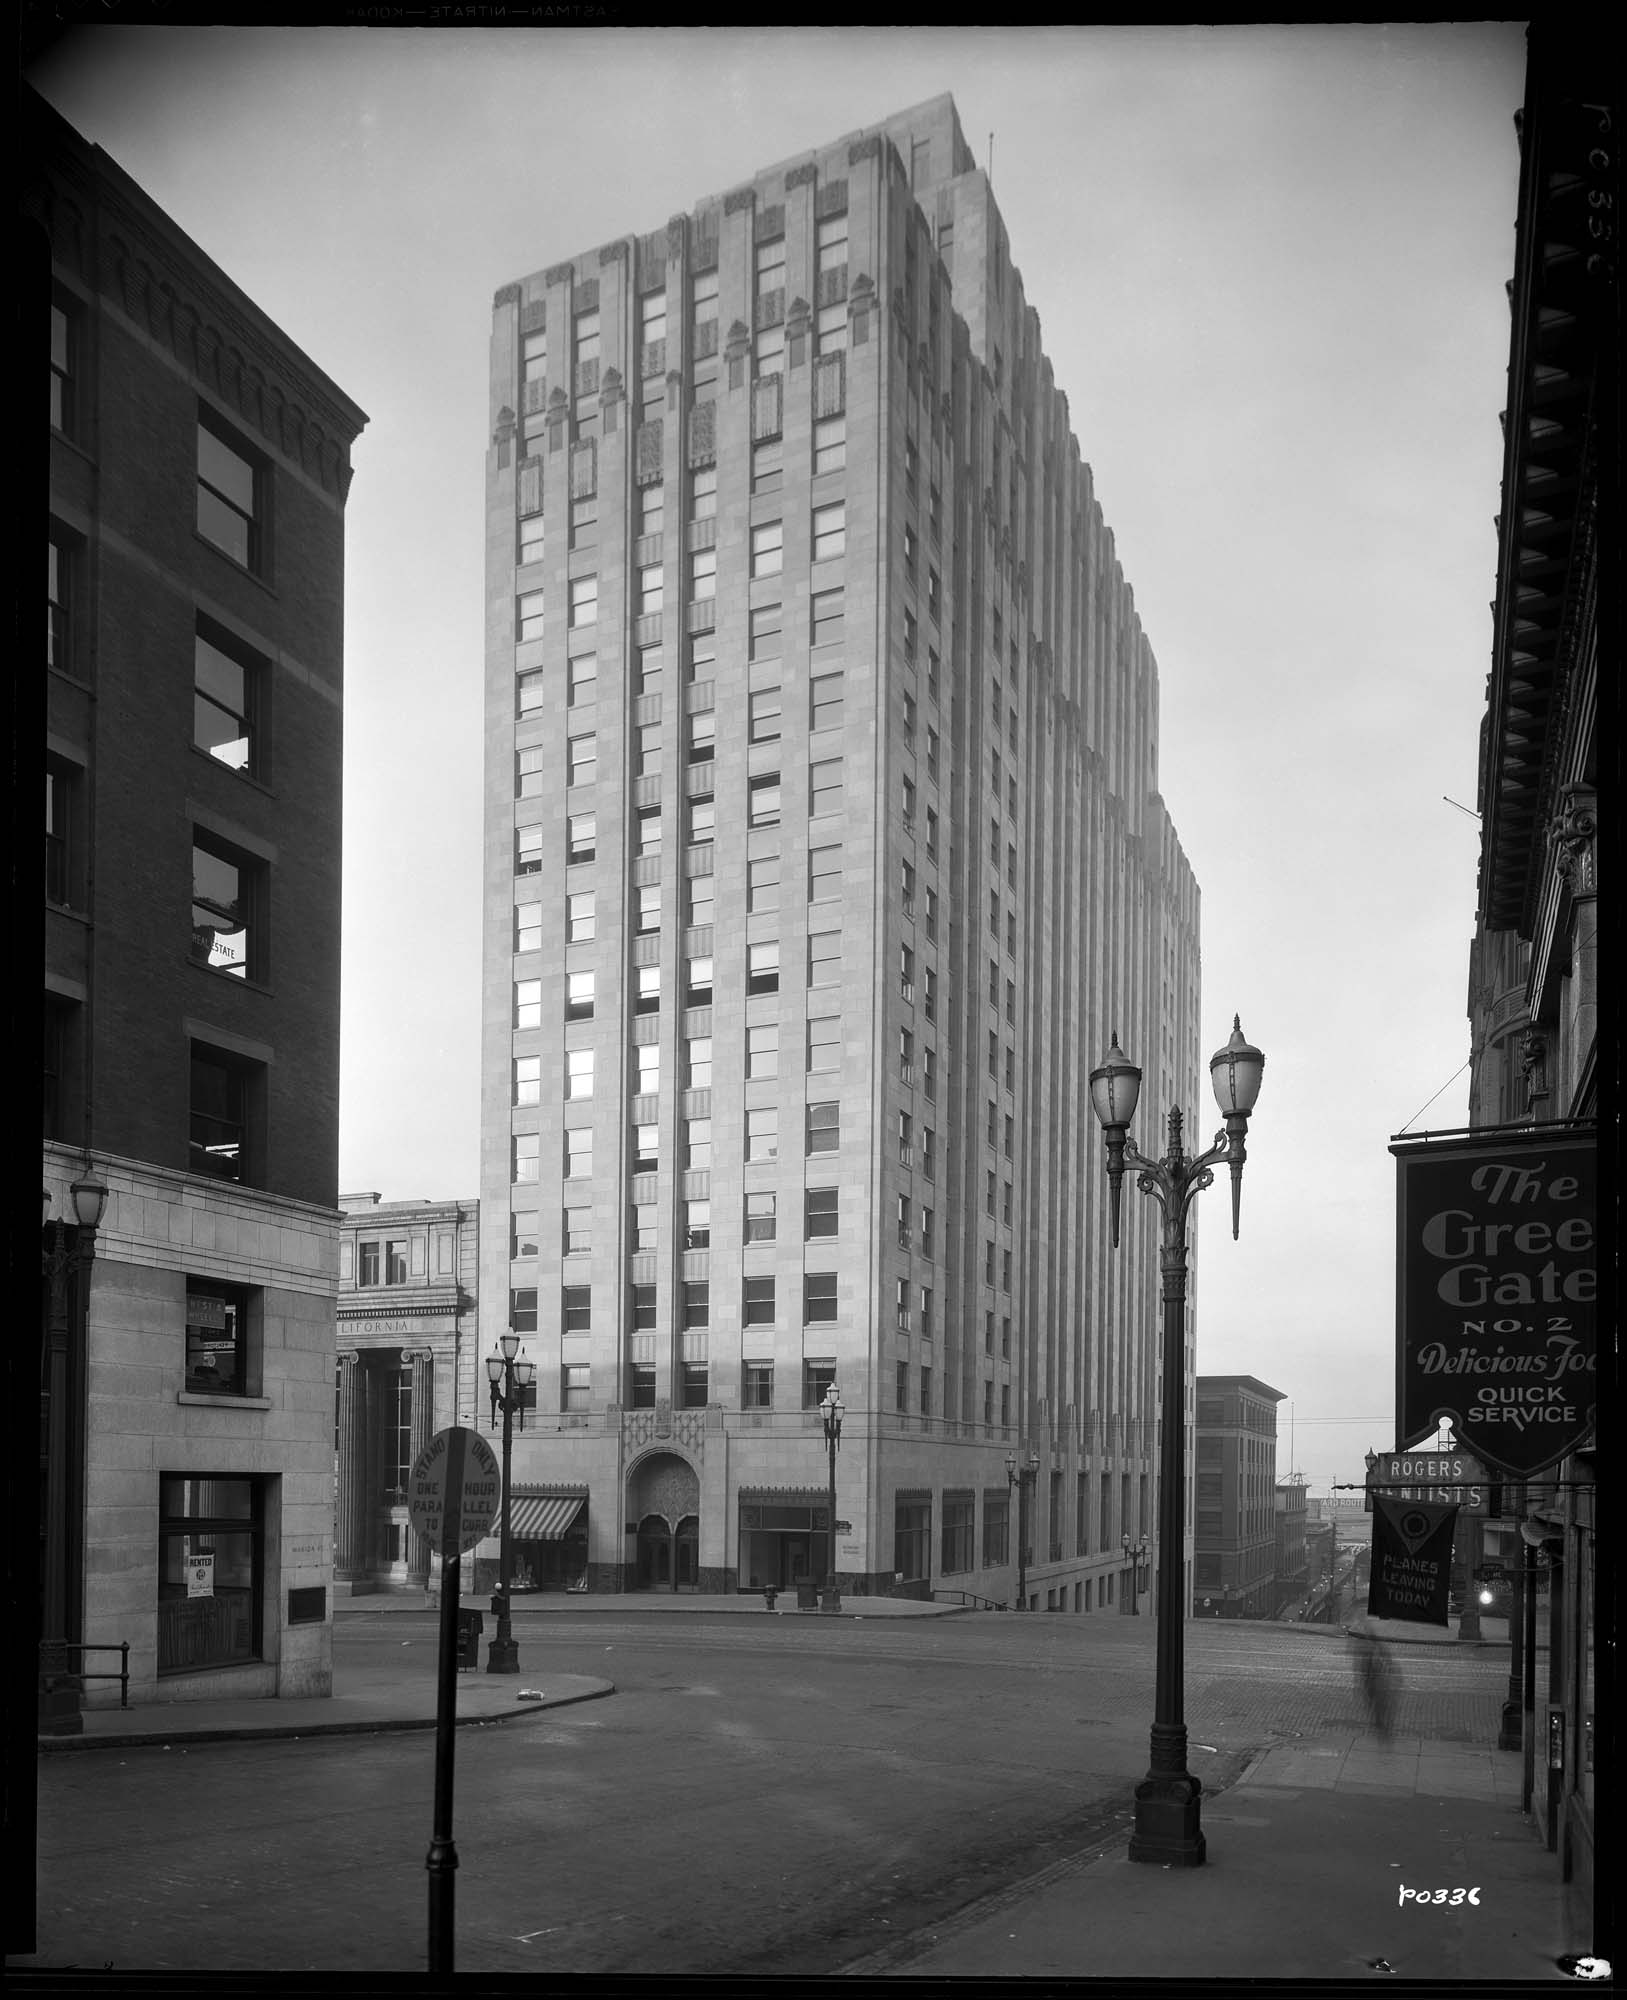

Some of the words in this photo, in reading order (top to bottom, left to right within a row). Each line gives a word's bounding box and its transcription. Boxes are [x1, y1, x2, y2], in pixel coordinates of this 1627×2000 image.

[1471, 1161, 1579, 1204] The
[1437, 1261, 1597, 1308] Gate
[1463, 1319, 1534, 1335] NO.
[1417, 1342, 1548, 1375] Delicious
[1477, 1386, 1567, 1406] QUICK
[1467, 1406, 1577, 1433] SERVICE
[416, 1438, 446, 1480] STAND
[471, 1441, 496, 1475] ONLY
[1391, 1460, 1463, 1477] ROGERS
[417, 1482, 440, 1495] ONE
[464, 1482, 496, 1496] HOUR
[425, 1518, 439, 1531] TO
[462, 1519, 489, 1532] CURB
[1383, 1554, 1440, 1576] PLANES
[1382, 1571, 1437, 1592] LEAVING
[1386, 1590, 1431, 1608] TODAY
